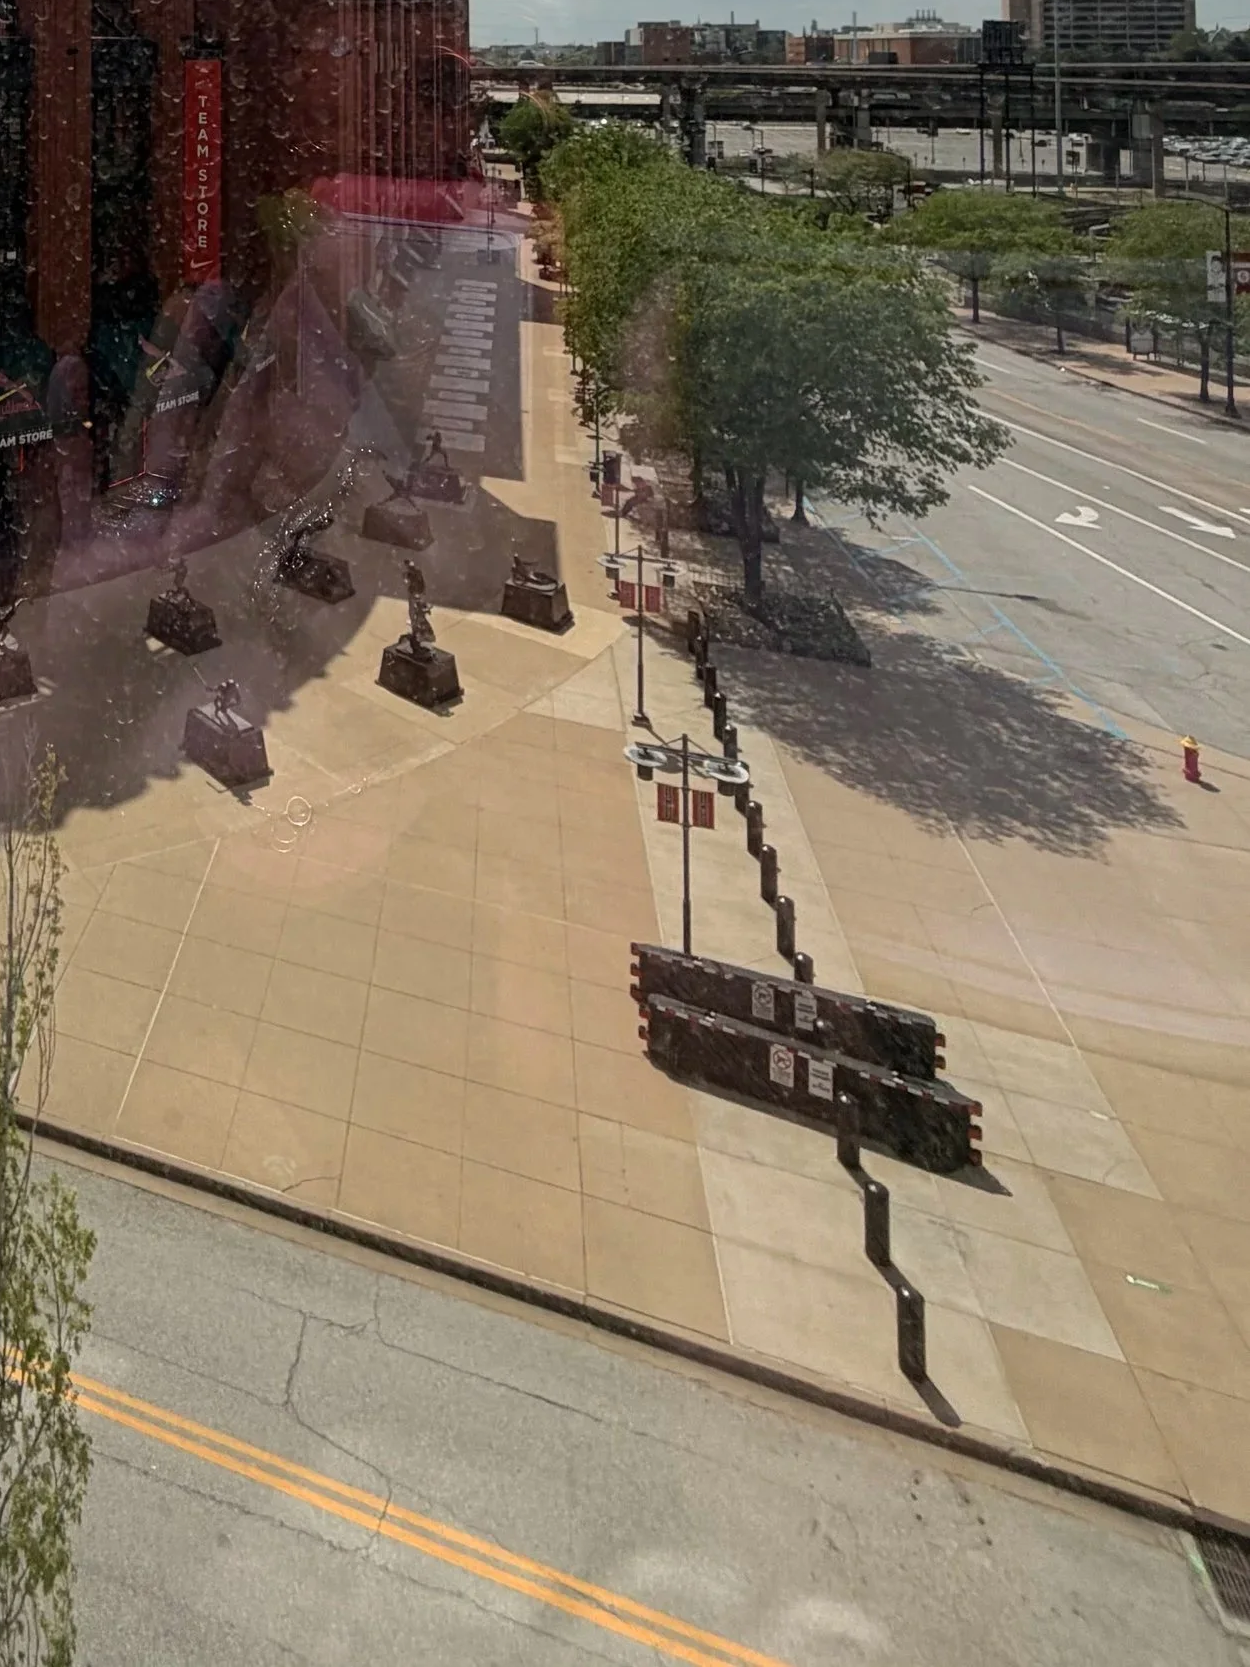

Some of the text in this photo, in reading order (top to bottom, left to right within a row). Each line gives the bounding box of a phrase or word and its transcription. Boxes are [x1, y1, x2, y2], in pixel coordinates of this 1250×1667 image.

[196, 95, 209, 248] TEAM STORE
[156, 390, 200, 414] TEAM STORE
[18, 429, 54, 445] STORE
